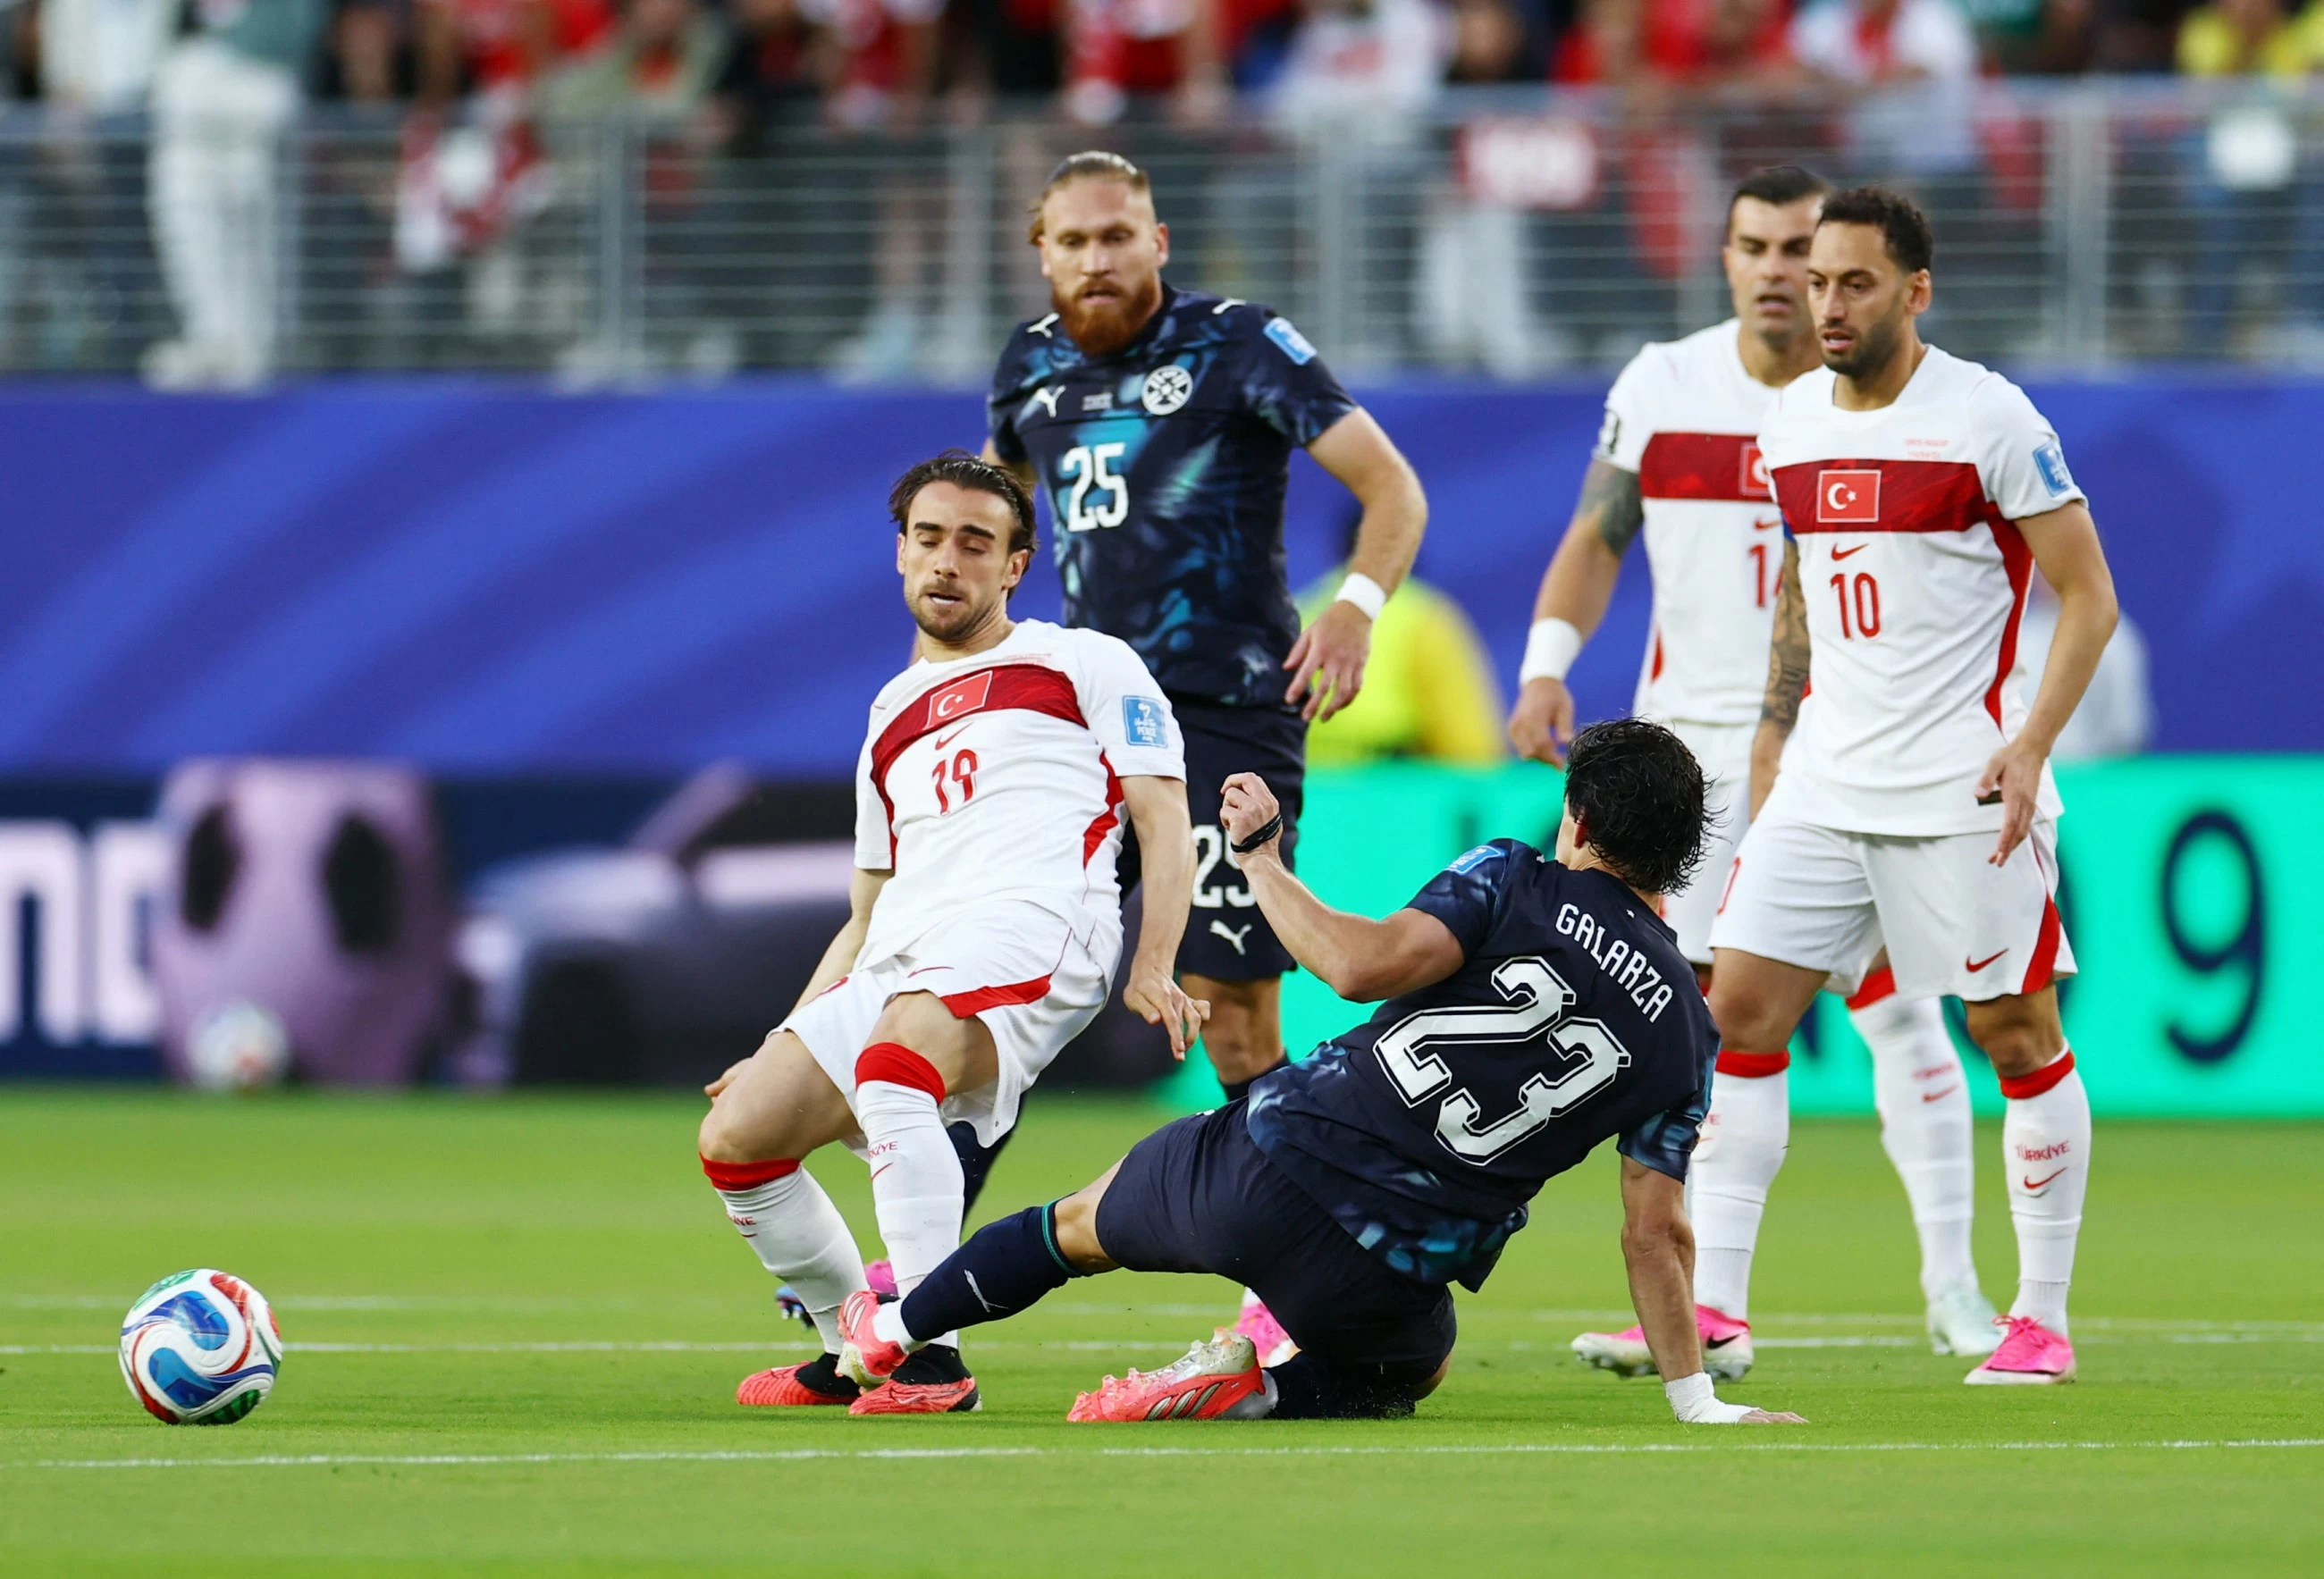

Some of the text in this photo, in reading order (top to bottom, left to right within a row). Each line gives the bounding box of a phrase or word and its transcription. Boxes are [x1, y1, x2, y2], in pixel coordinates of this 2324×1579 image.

[1062, 441, 1129, 533] 25
[1829, 572, 1882, 641] 10
[932, 748, 980, 817] 19
[1554, 903, 1674, 1023] GALARZA
[1372, 954, 1632, 1167] 23
